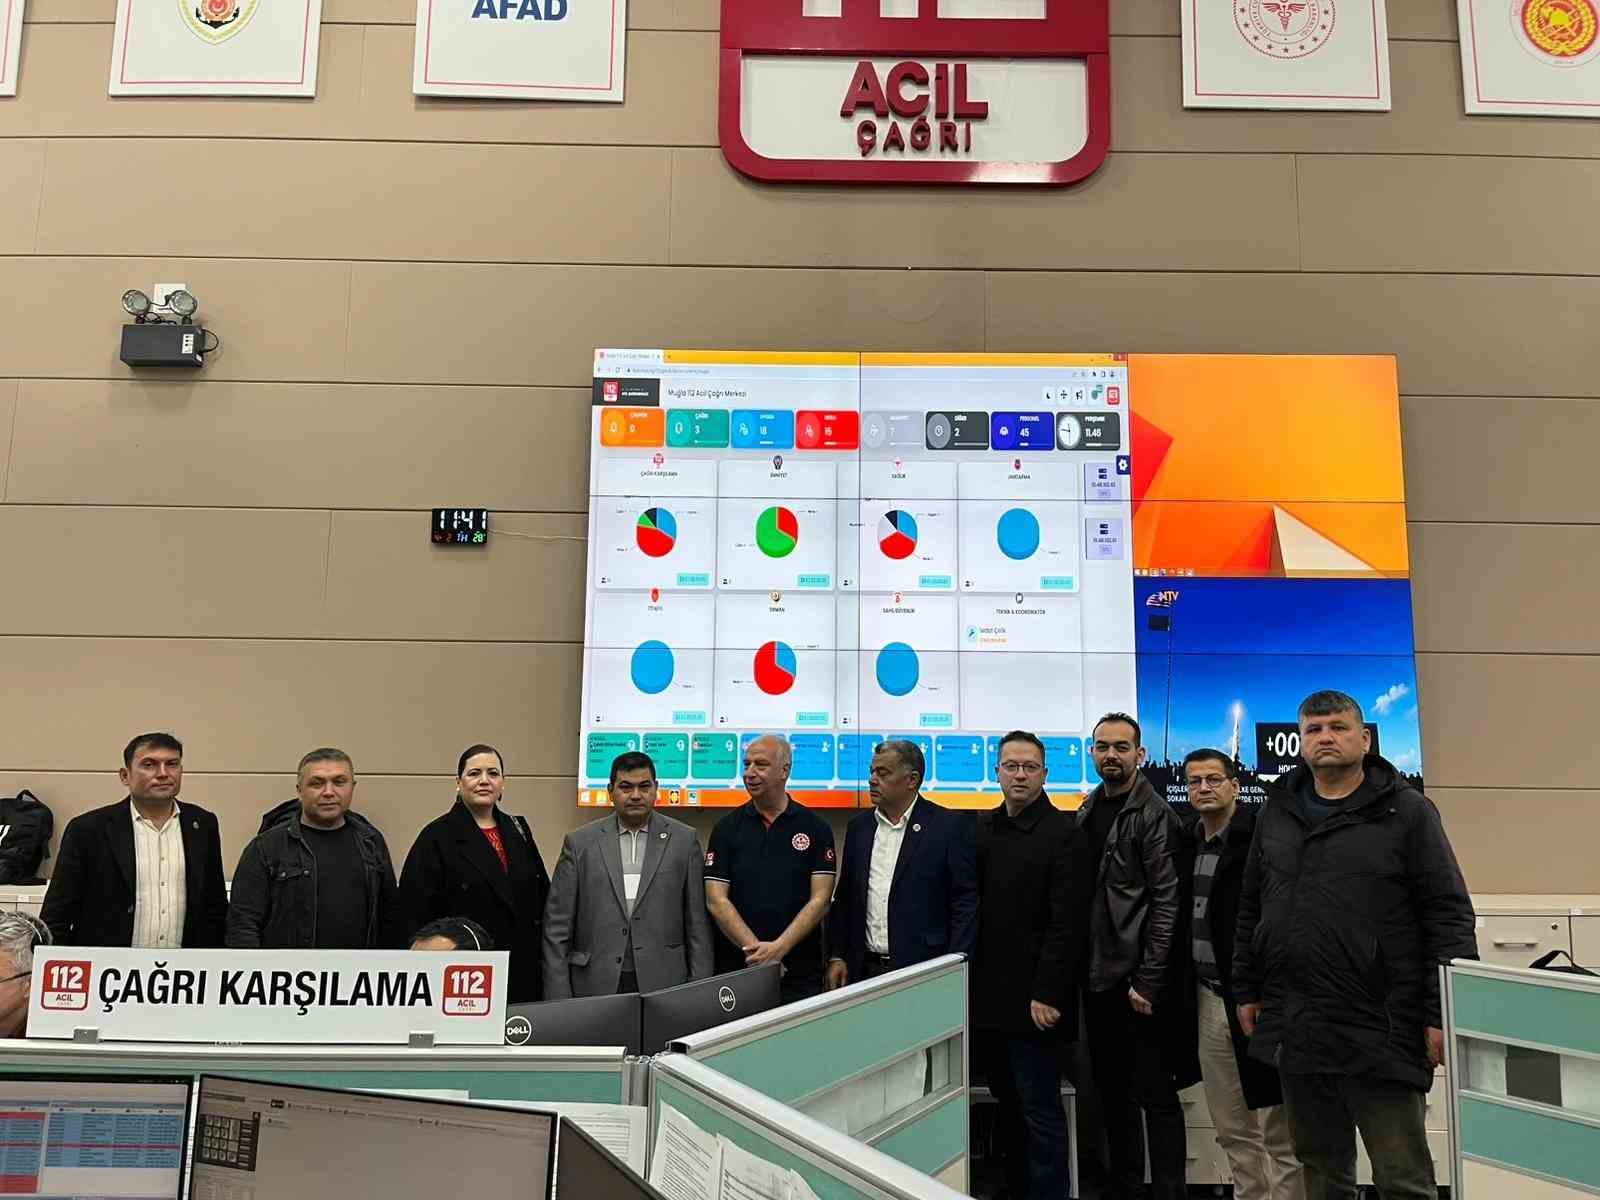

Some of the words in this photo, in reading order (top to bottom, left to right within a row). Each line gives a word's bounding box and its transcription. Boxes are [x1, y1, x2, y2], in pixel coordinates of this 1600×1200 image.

[471, 0, 568, 20] AFAD
[840, 61, 989, 119] ACİL
[857, 115, 971, 157] ÇAĞRI
[440, 510, 487, 529] 11:41
[51, 965, 84, 989] 112
[99, 961, 207, 1013] ÇAĞRI
[219, 970, 433, 1015] KARŞILAMA
[451, 970, 485, 994] 112
[507, 1026, 529, 1036] DELL
